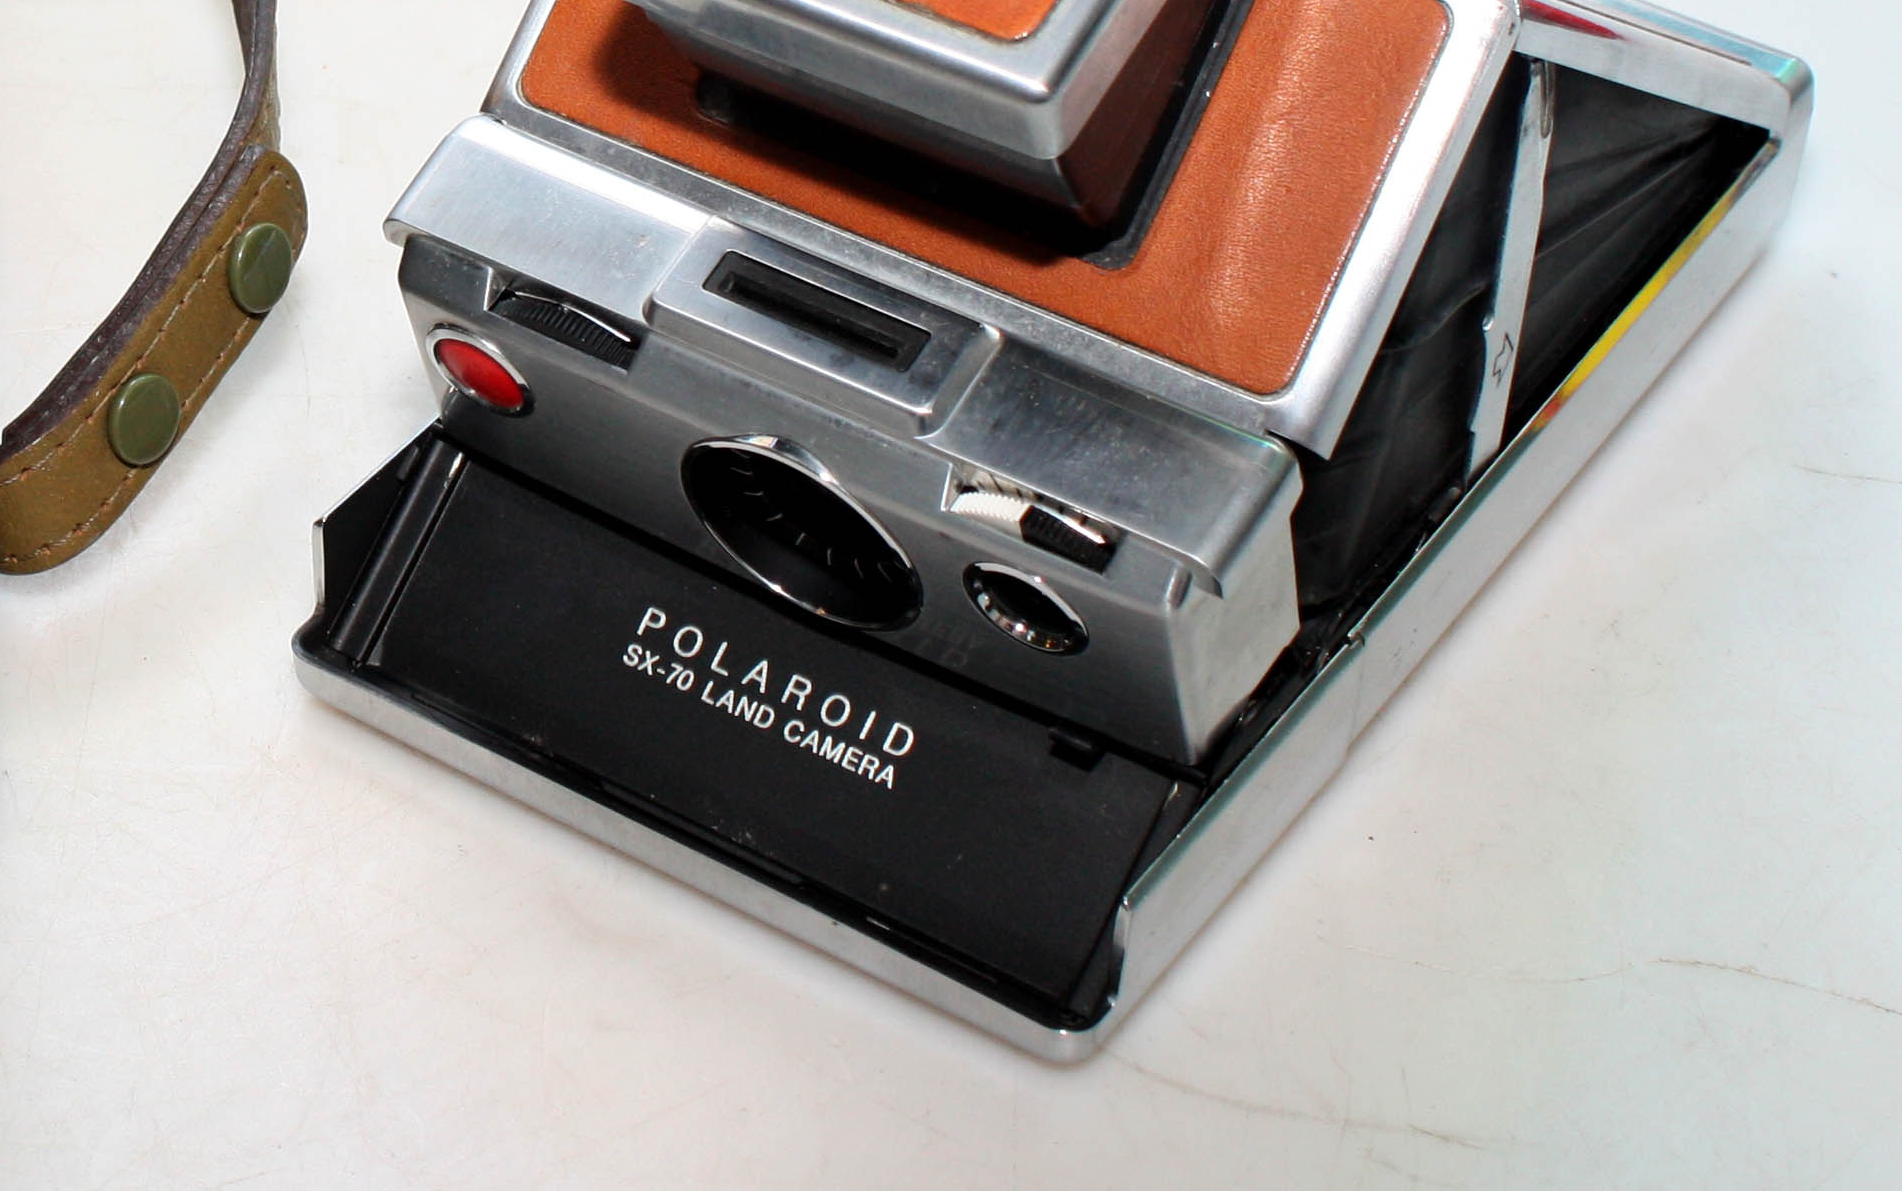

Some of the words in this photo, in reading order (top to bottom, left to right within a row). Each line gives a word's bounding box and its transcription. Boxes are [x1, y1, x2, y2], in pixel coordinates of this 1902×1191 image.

[622, 642, 695, 692] SX-70
[700, 680, 775, 731] LAND
[783, 719, 896, 790] CAMERA
[636, 606, 915, 758] POLAROID
